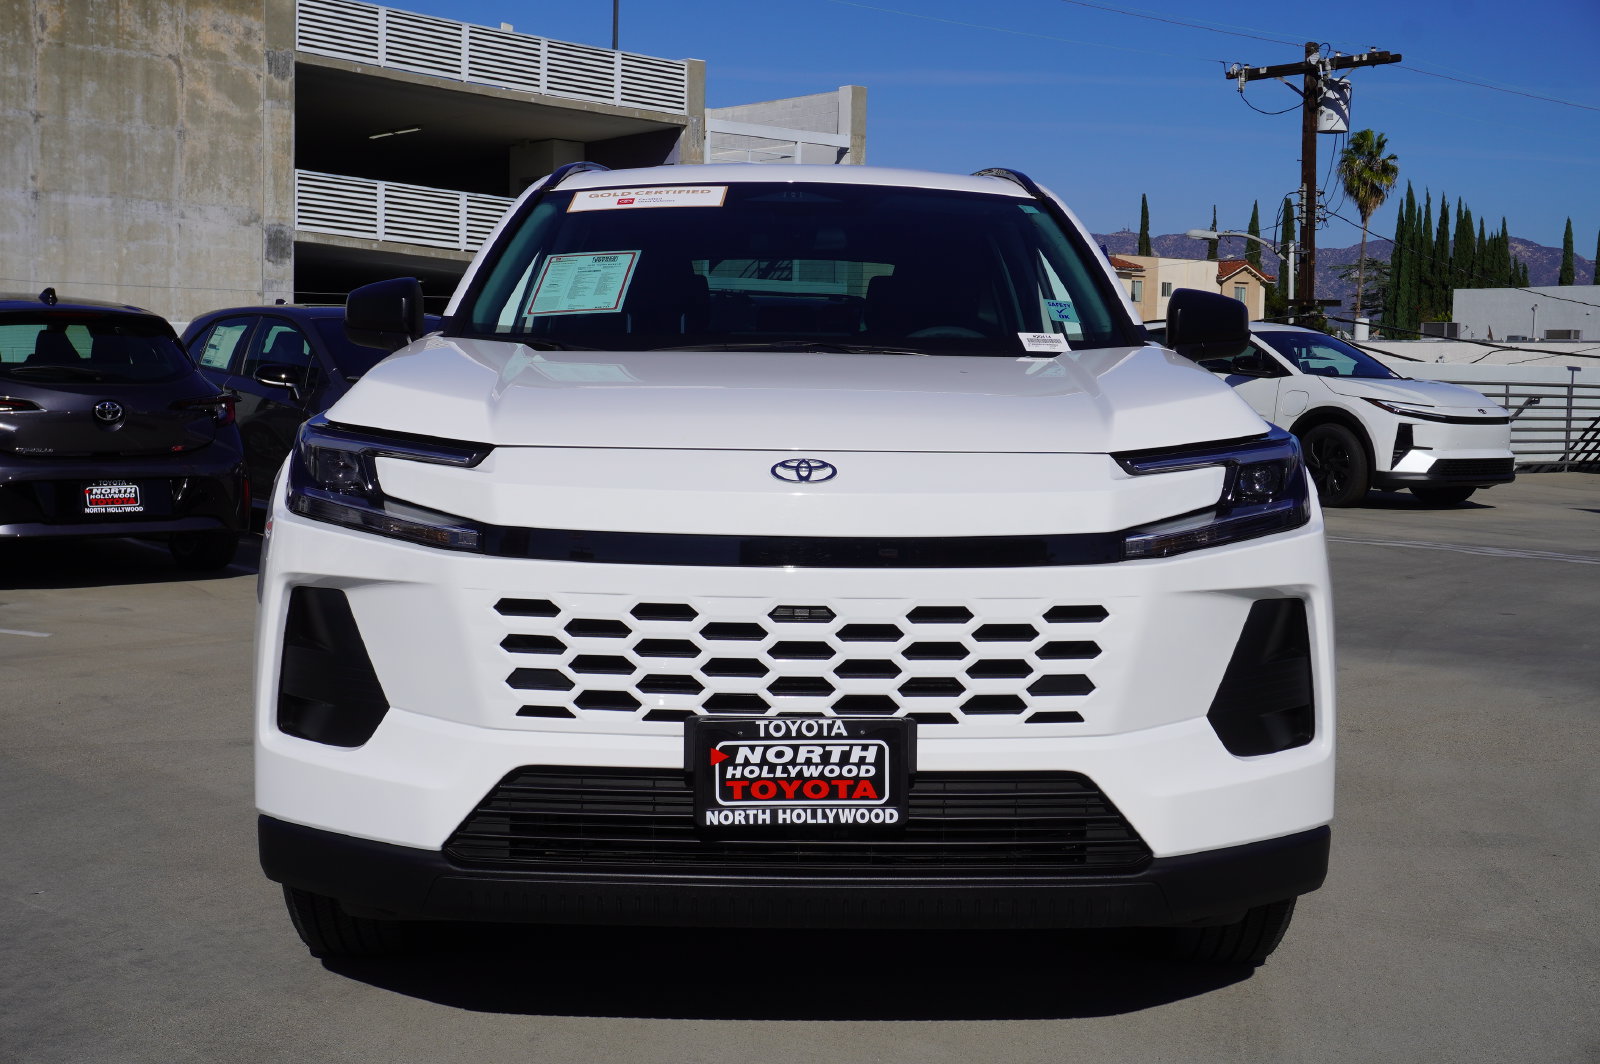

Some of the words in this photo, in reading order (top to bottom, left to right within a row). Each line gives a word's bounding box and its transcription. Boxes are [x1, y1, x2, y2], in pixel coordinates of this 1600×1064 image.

[588, 191, 632, 199] GOLD
[92, 487, 136, 495] NORTH
[755, 720, 848, 737] TOYOTA
[734, 745, 878, 764] NORTH
[725, 765, 876, 778] HOLLYWOOD
[725, 779, 878, 800] TOYOTA
[705, 809, 771, 825] NORTH
[777, 808, 899, 824] HOLLYWOOD
